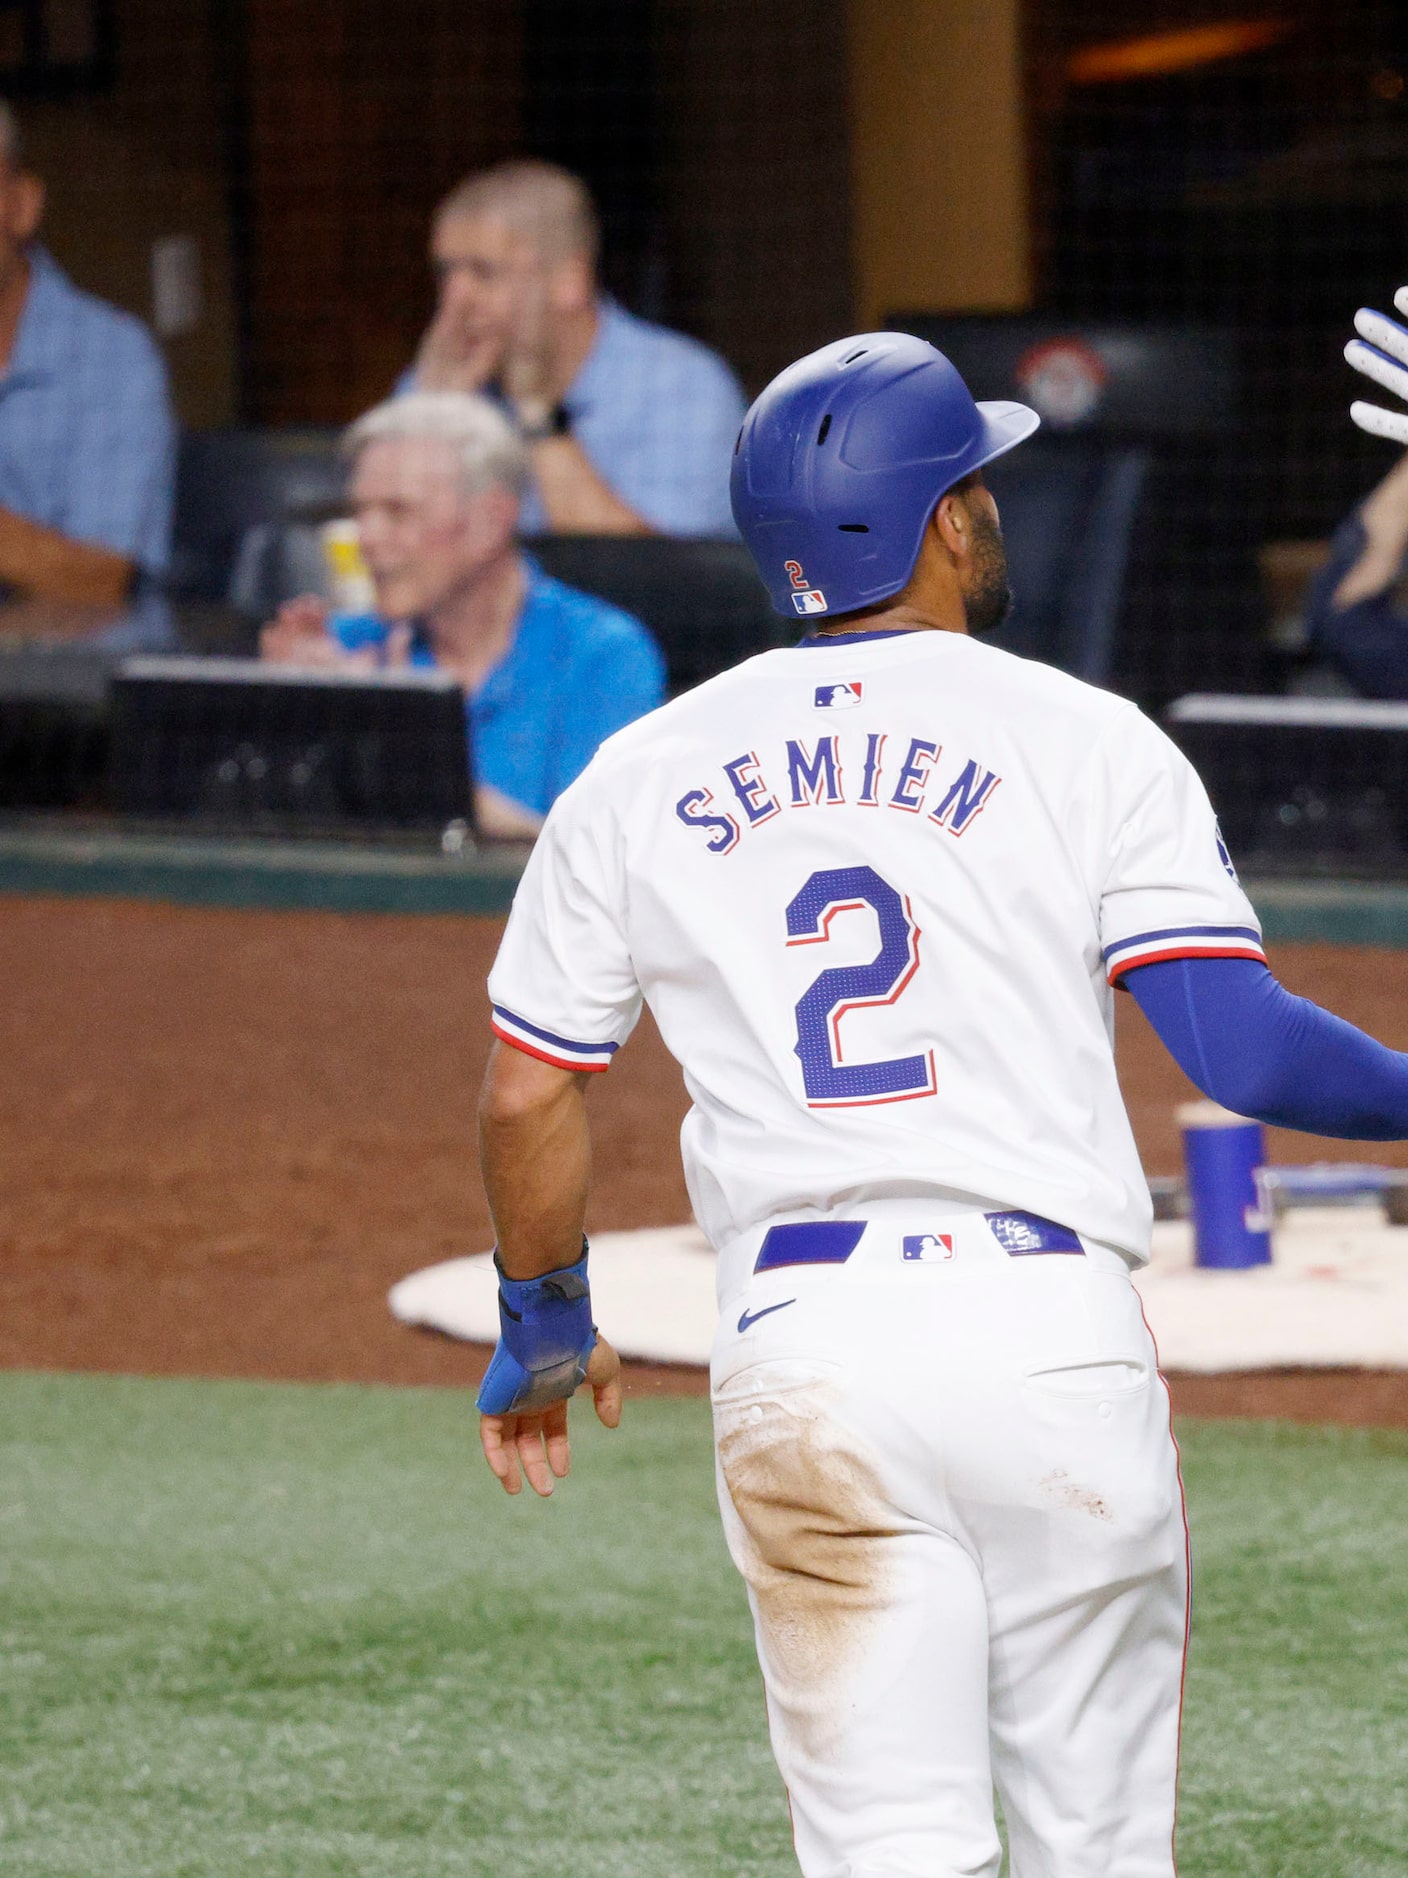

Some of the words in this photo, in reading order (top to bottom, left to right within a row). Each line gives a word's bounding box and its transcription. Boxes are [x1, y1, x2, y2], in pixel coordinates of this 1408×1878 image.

[783, 559, 810, 589] 2
[675, 733, 1003, 856] SEMIEN
[784, 864, 938, 1108] 2
